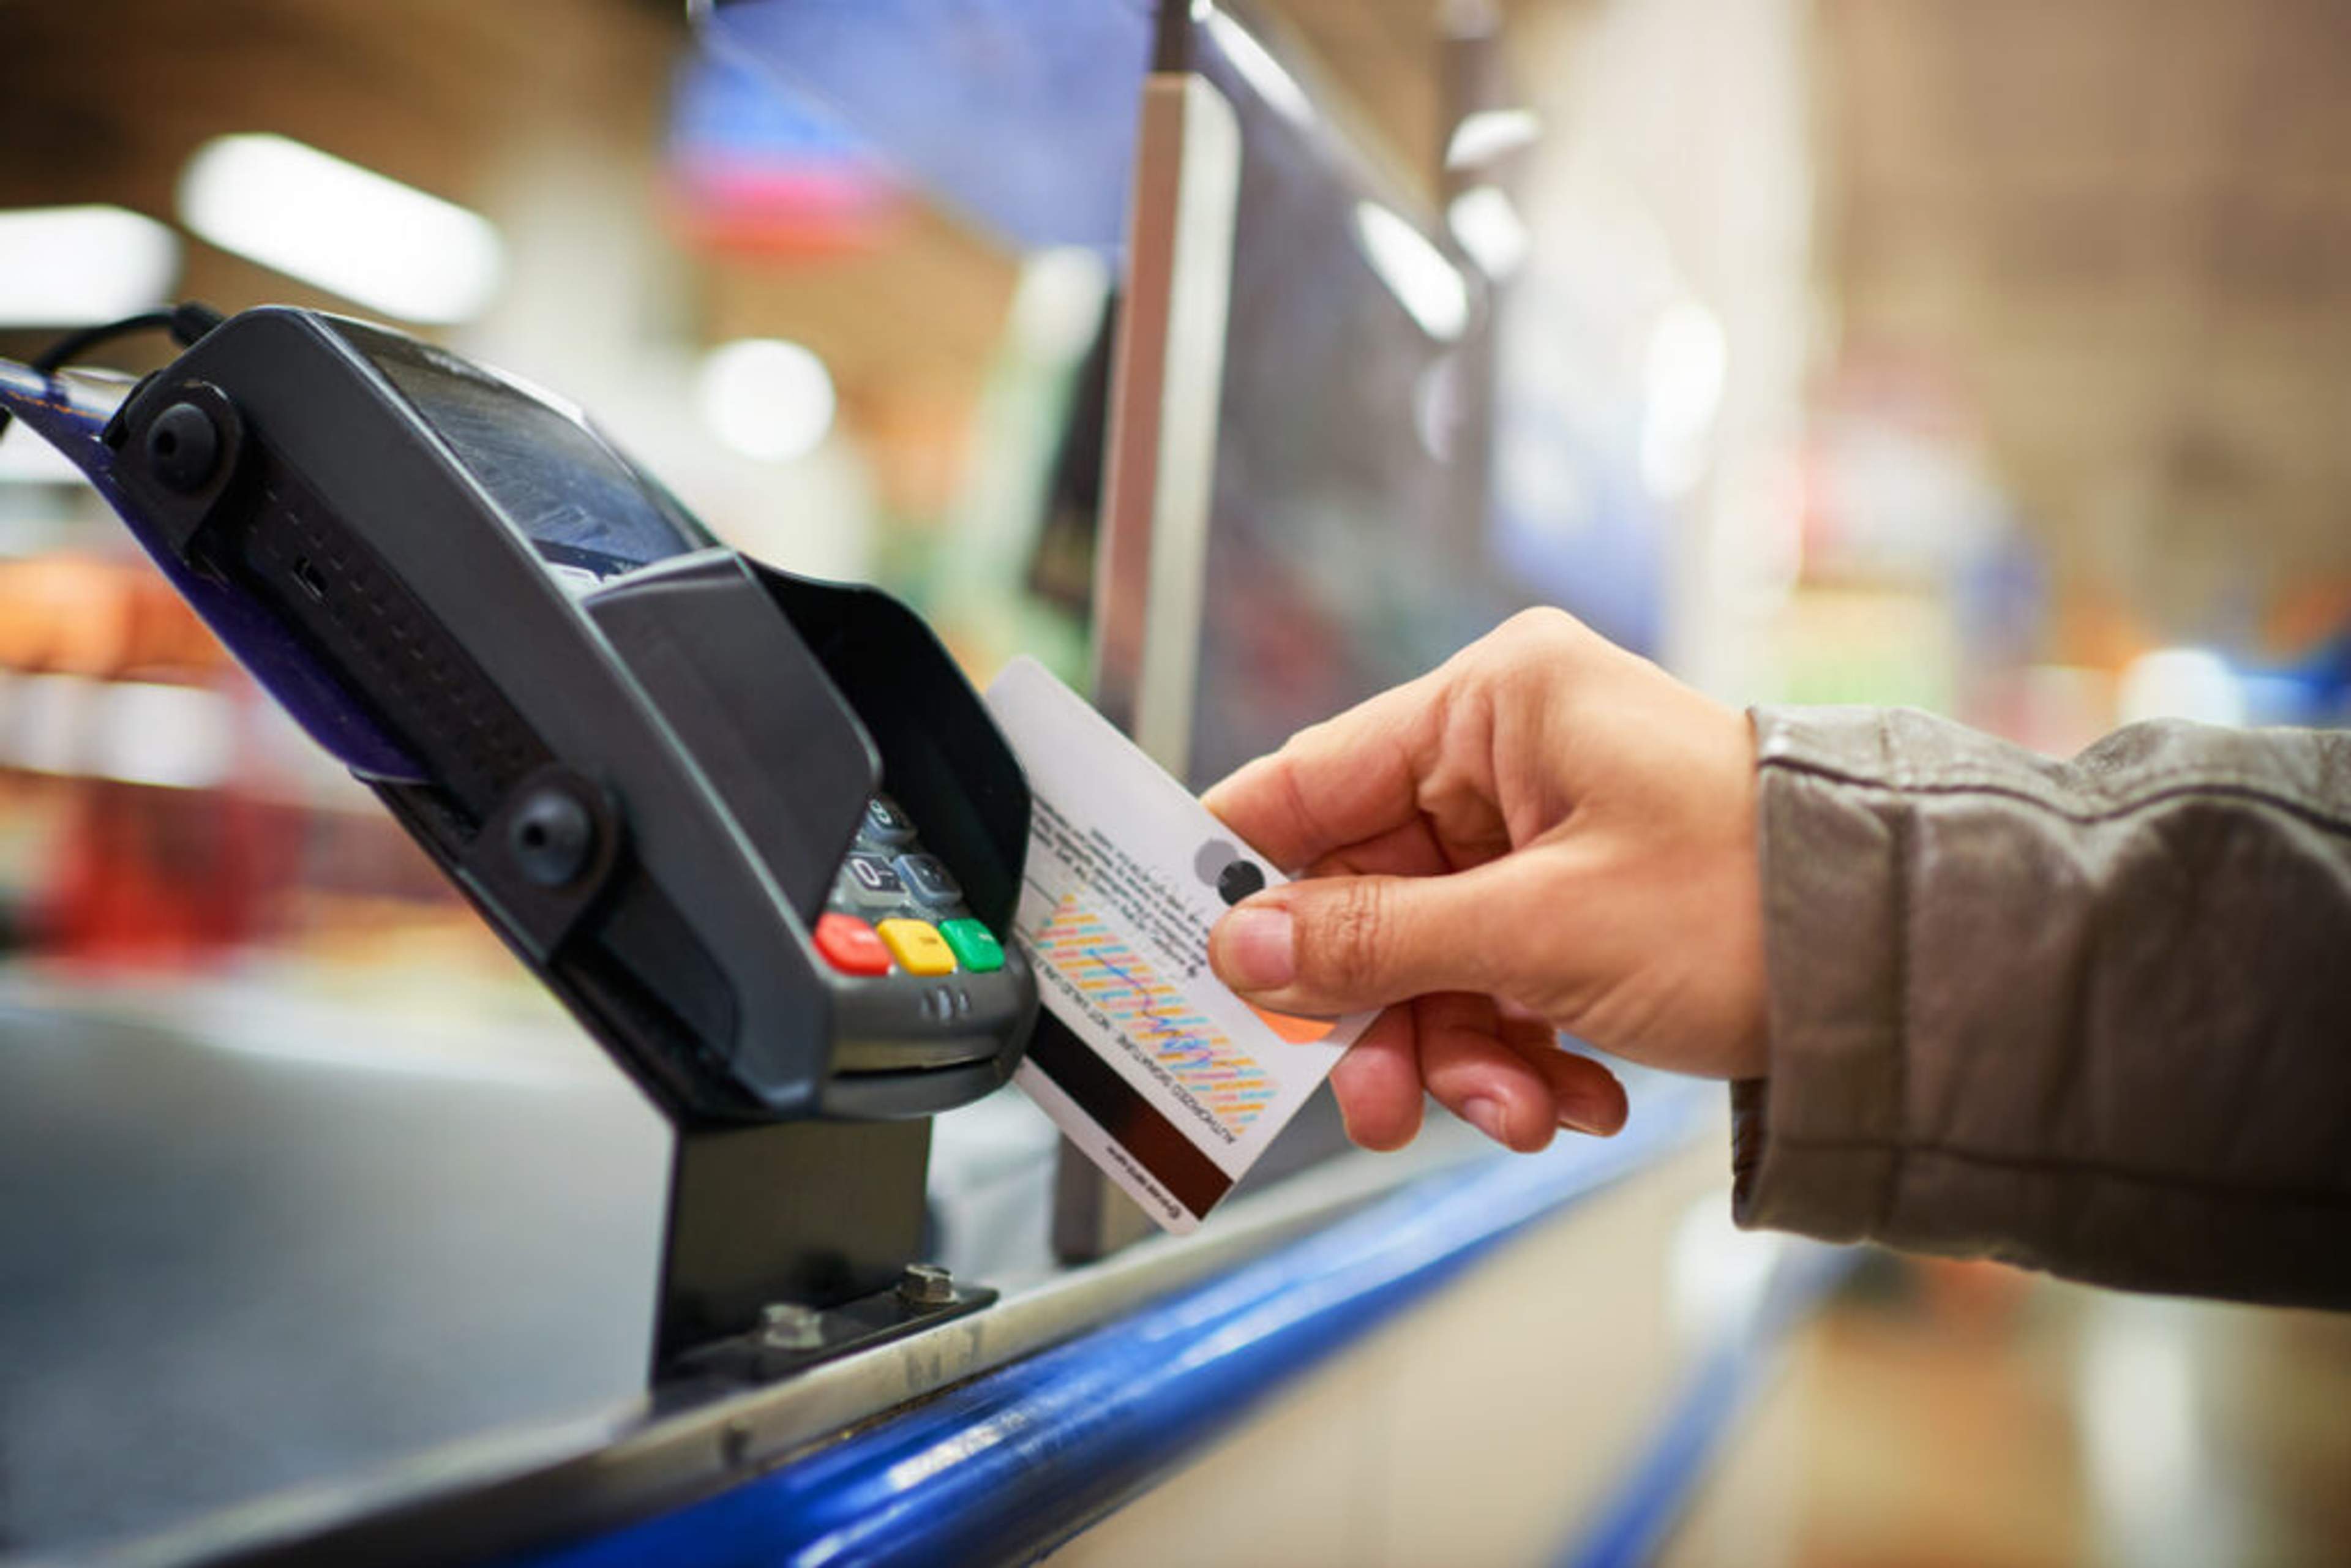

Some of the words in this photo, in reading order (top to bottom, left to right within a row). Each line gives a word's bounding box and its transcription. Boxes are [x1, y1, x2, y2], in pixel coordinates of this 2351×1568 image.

[1087, 1010, 1111, 1030] NOT
[1118, 1033, 1172, 1087] SIGNATURE
[1170, 1082, 1237, 1145] AUTHORIZED
